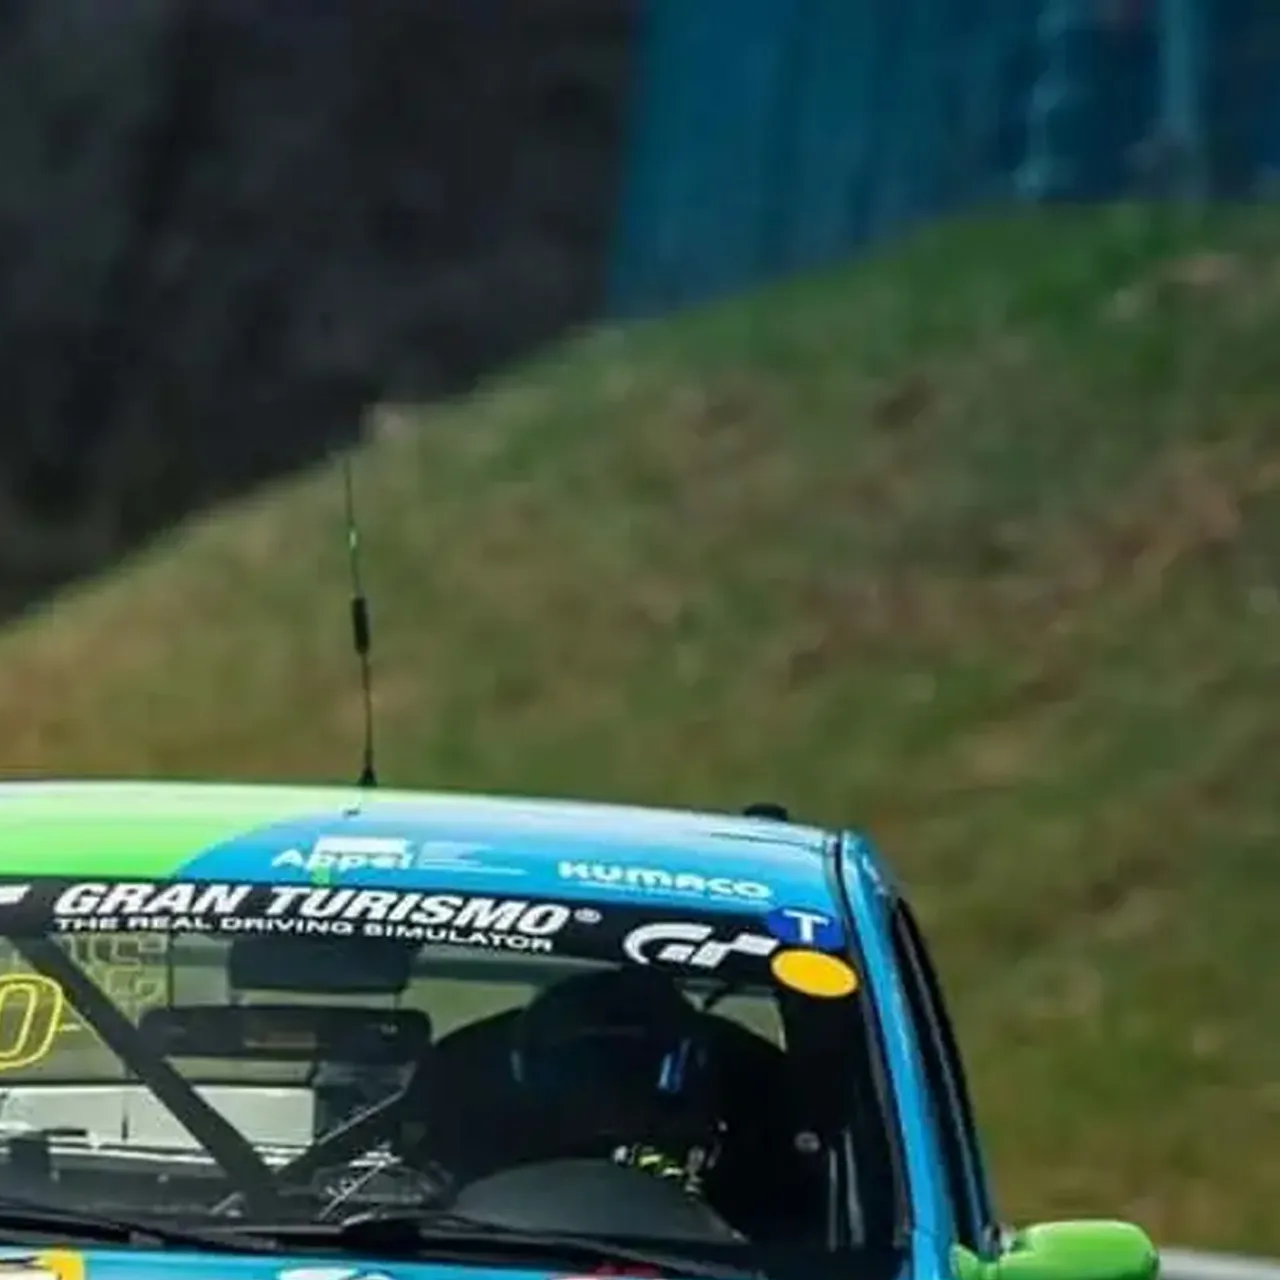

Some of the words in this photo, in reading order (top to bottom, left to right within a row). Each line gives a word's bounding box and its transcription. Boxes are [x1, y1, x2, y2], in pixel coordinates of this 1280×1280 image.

[53, 883, 252, 915] GRAN
[54, 916, 119, 931] THE
[127, 916, 213, 931] REAL
[219, 917, 355, 936] DRIVING
[363, 922, 554, 952] SIMULATOR
